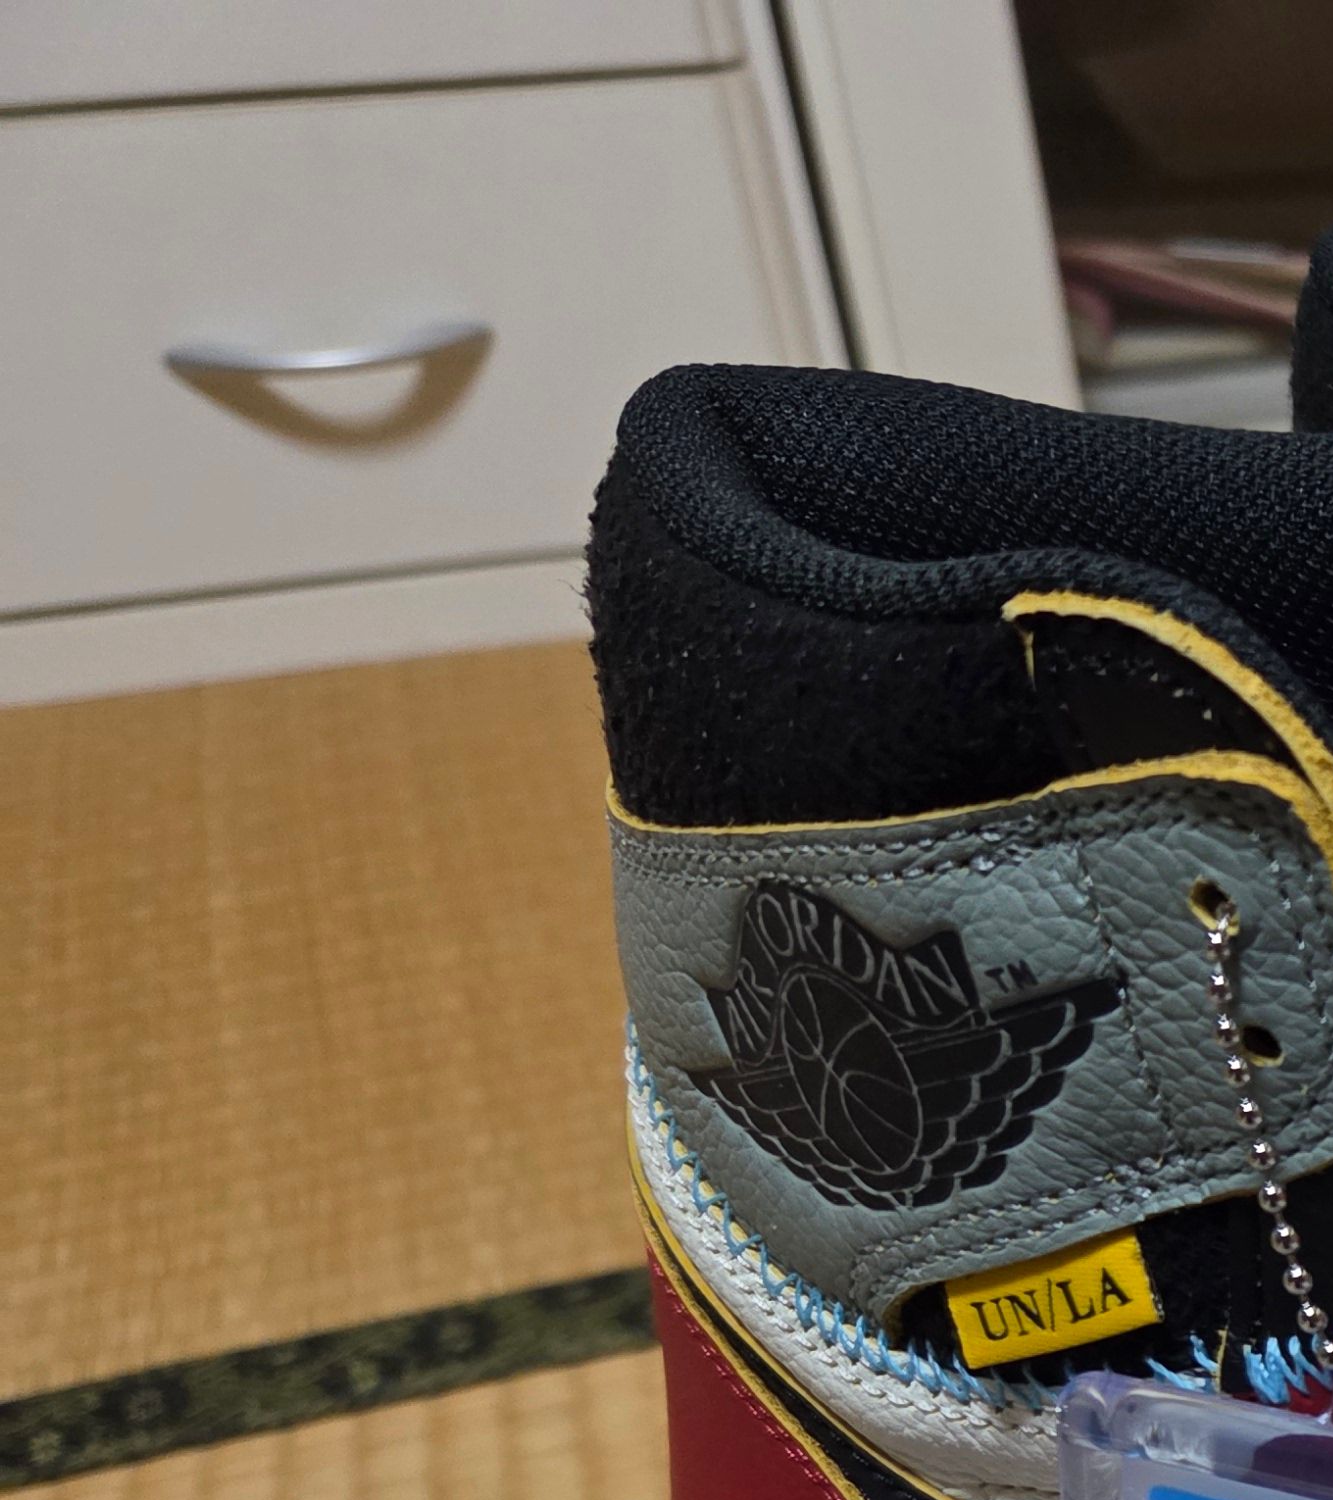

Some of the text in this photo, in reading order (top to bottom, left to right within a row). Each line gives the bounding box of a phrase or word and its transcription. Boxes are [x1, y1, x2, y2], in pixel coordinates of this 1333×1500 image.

[726, 891, 971, 1052] AIR JORDAN
[970, 1267, 1133, 1341] UN/LA
